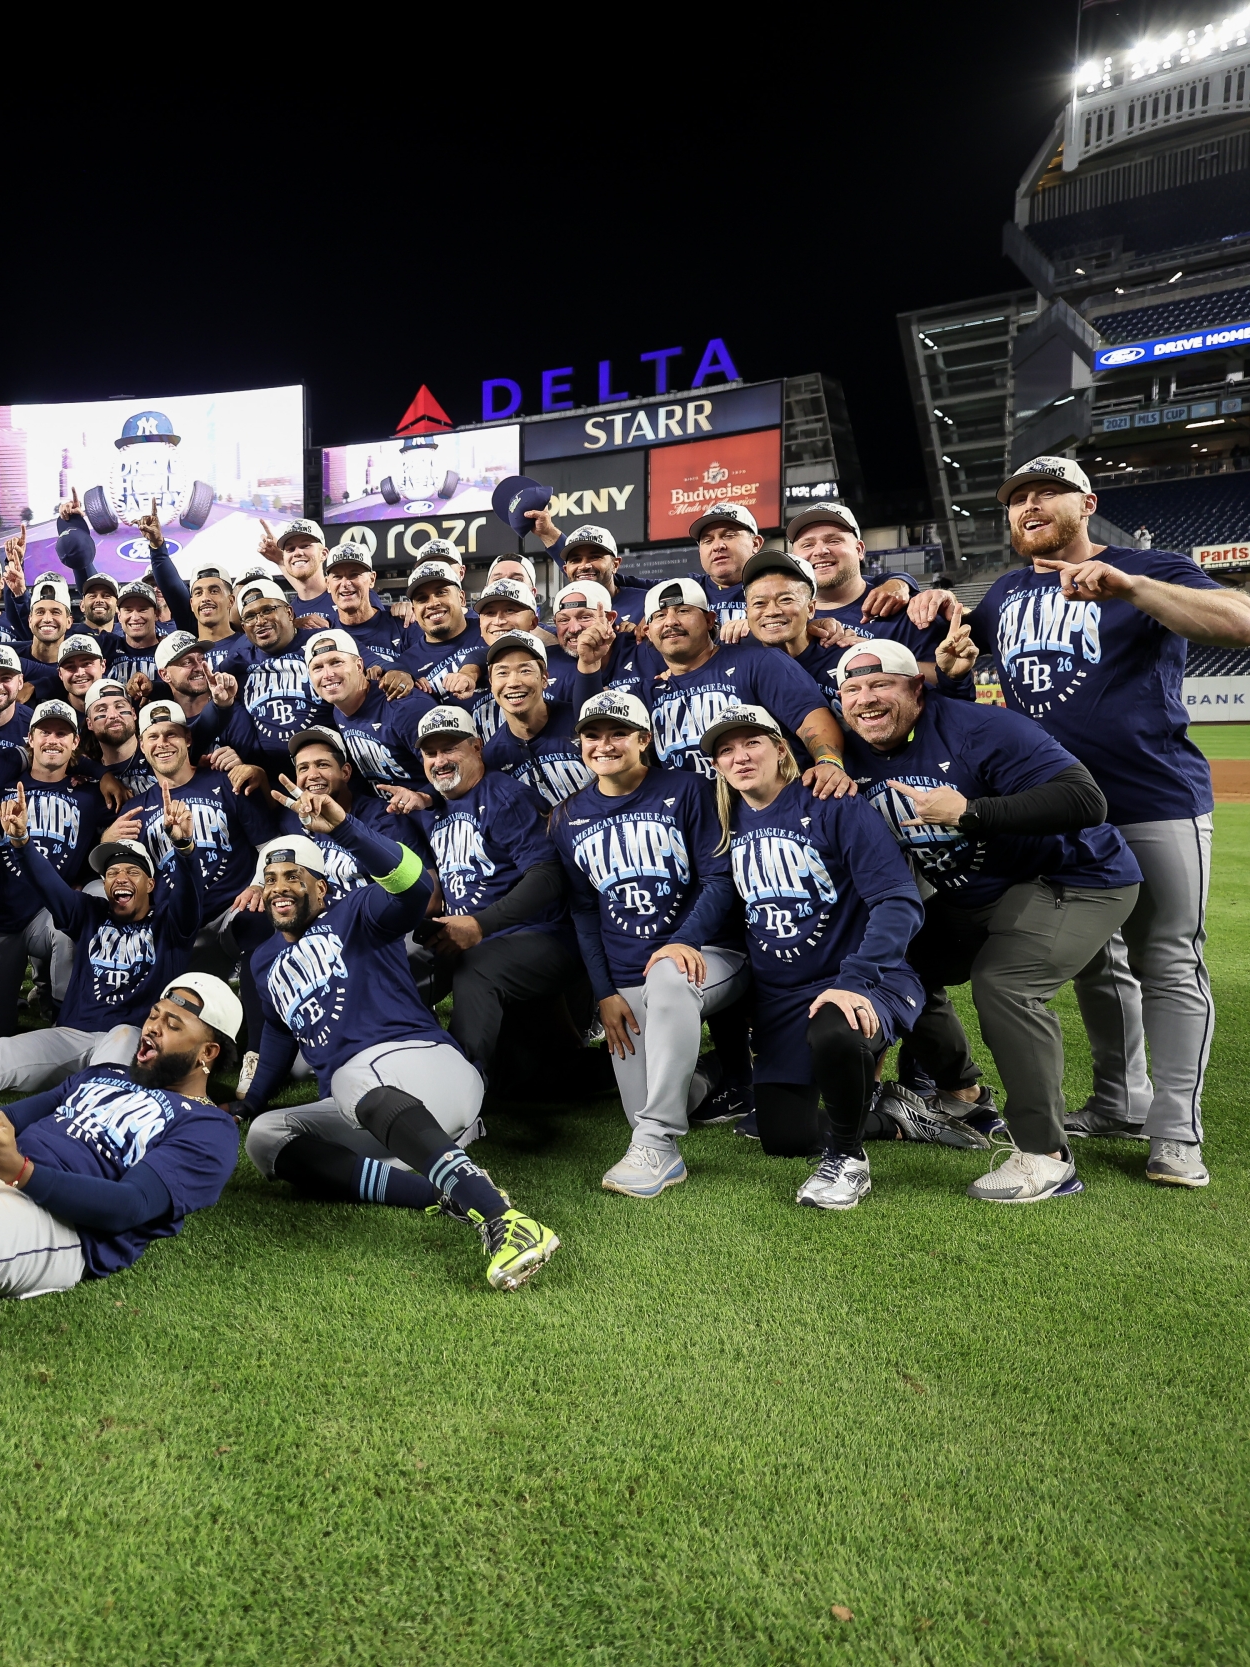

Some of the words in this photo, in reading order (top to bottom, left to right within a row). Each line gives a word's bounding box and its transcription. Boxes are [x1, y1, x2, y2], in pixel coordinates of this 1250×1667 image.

[1153, 336, 1203, 356] DRIVE
[1206, 327, 1250, 346] HOME
[482, 338, 740, 421] DELTA
[584, 400, 713, 449] STARR
[1106, 418, 1128, 430] 2021
[1138, 413, 1157, 424] MLS
[1165, 409, 1186, 420] CUP
[671, 482, 760, 504] Budweiser
[669, 502, 702, 516] Made
[387, 517, 487, 559] rozr
[568, 534, 604, 544] CHAMPIONS
[332, 552, 364, 562] CHAMPIONS
[1200, 547, 1249, 563] Parts
[716, 602, 747, 610] LEAGUE
[854, 626, 875, 640] EAST
[997, 597, 1101, 672] CHAMPS
[624, 677, 641, 687] EAST
[1015, 655, 1054, 693] TB
[1057, 657, 1072, 673] 26
[685, 683, 717, 697] LEAGUE
[716, 683, 737, 695] EAST
[1029, 701, 1051, 715] BAY
[1057, 669, 1087, 702] RAYS
[1187, 693, 1245, 706] BANK
[257, 706, 266, 717] 20
[267, 699, 296, 726] TB
[296, 699, 307, 710] 26
[585, 704, 630, 718] CHAMPIONS
[421, 718, 460, 735] CHAMPIONS
[537, 752, 565, 764] LEAGUE
[671, 755, 684, 769] 20
[895, 775, 931, 786] LEAGUE
[931, 779, 958, 791] EAST
[206, 798, 223, 809] EAST
[572, 818, 615, 847] AMERICAN
[615, 812, 653, 824] LEAGUE
[654, 814, 677, 826] EAST
[755, 827, 787, 839] LEAGUE
[788, 831, 813, 846] EAST
[52, 843, 62, 854] 26
[205, 850, 217, 863] 26
[574, 821, 691, 895] CHAMPS
[615, 882, 658, 916] TB
[655, 881, 671, 897] 26
[755, 903, 800, 939] TB
[796, 901, 813, 918] 26
[316, 924, 333, 935] EAST
[635, 923, 657, 935] BAY
[776, 947, 801, 960] BAY
[266, 932, 349, 1031] CHAMPS
[88, 1076, 141, 1093] AMERICAN
[161, 1100, 175, 1122] EAST
[66, 1082, 166, 1168] CHAMPS
